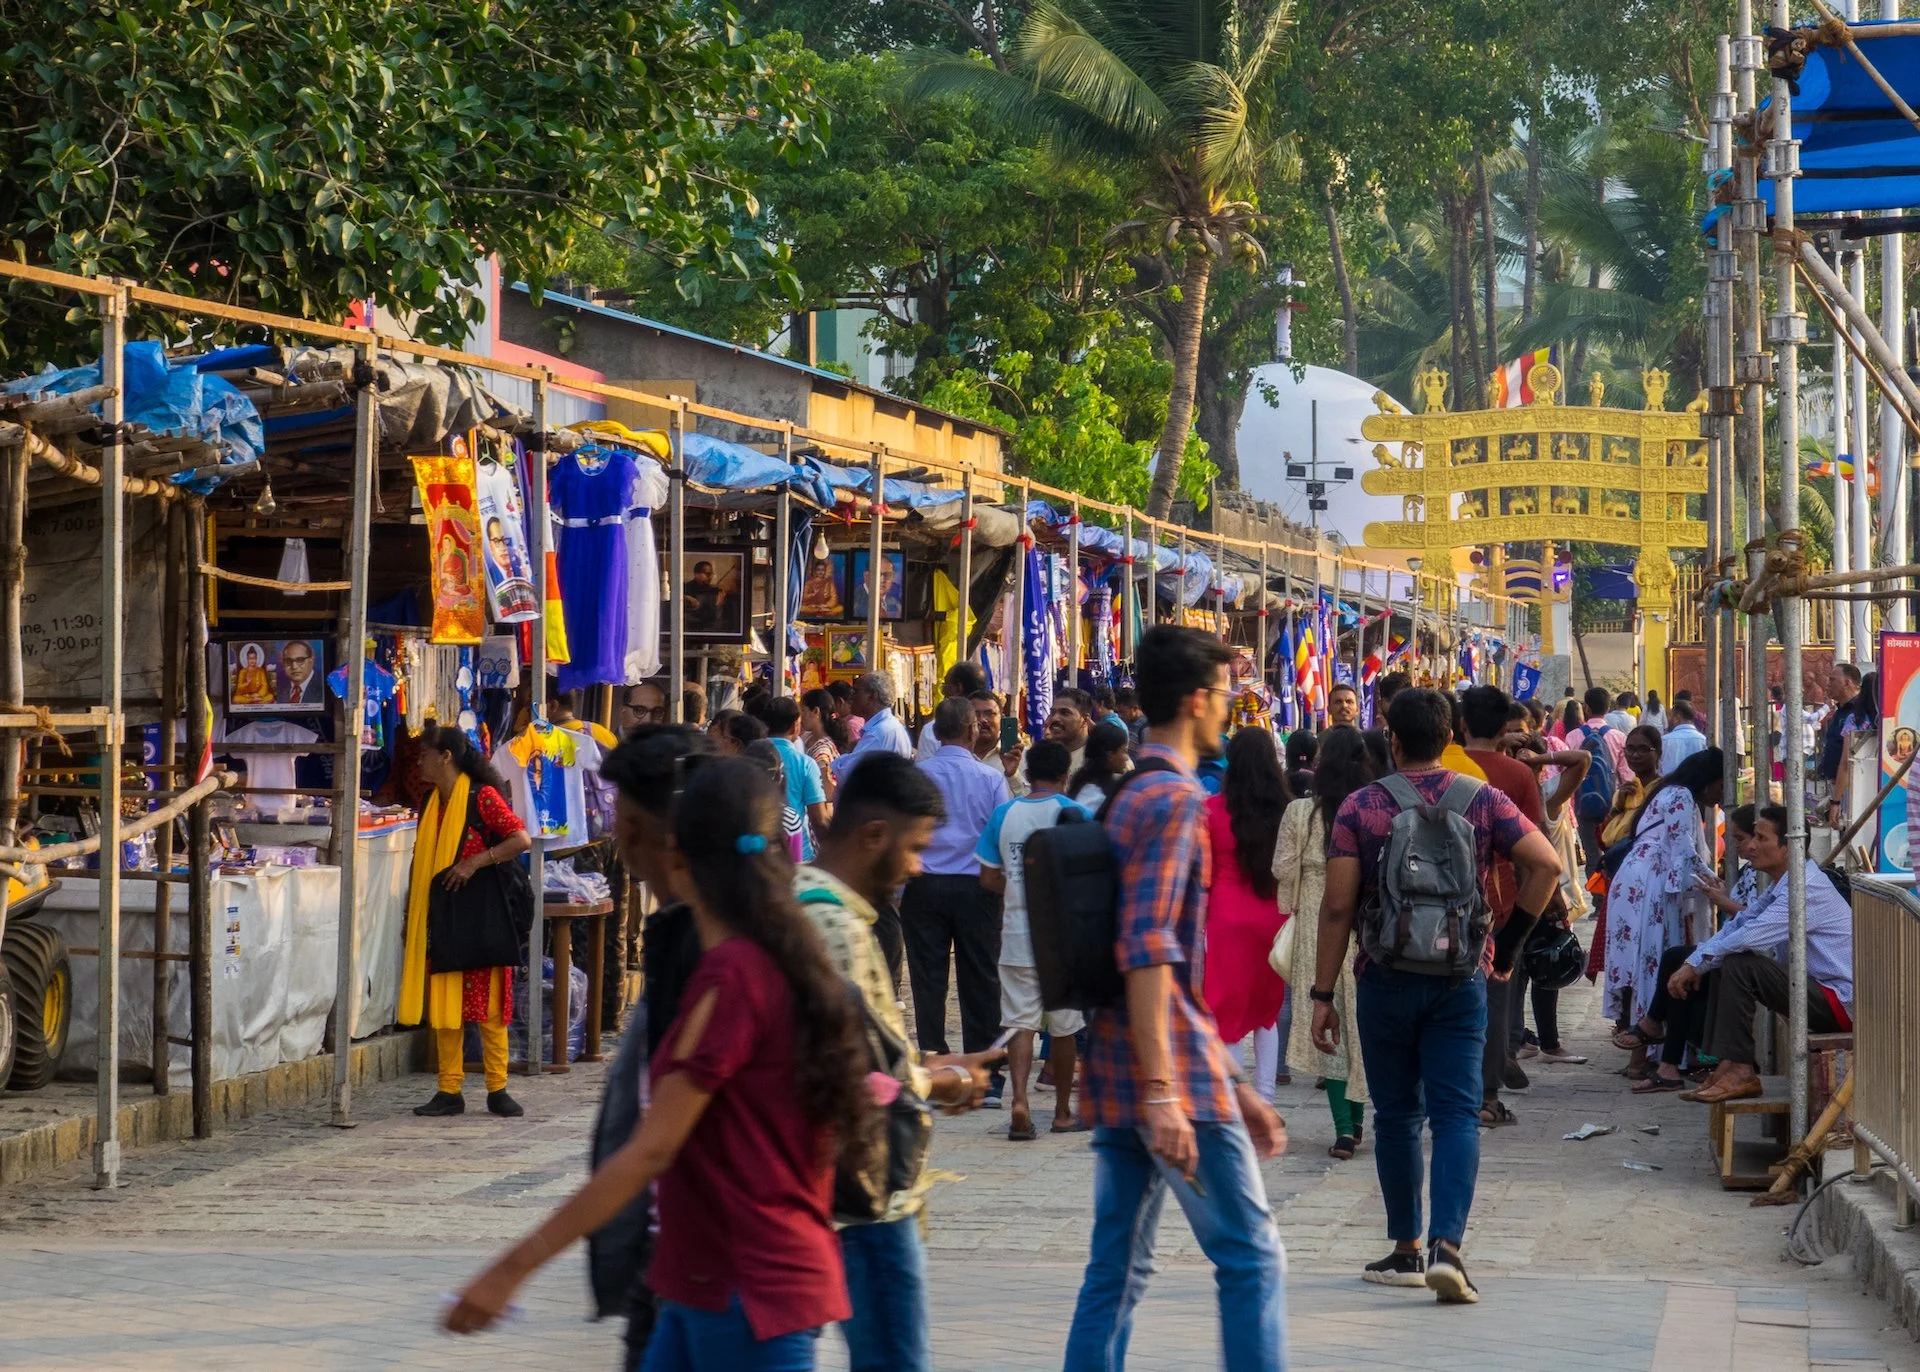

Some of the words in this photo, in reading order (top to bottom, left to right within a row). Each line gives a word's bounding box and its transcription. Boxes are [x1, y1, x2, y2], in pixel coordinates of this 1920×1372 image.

[24, 526, 46, 537] ne,
[50, 517, 83, 533] 7:00
[87, 518, 103, 531] p.
[52, 614, 94, 632] 11:30
[21, 641, 39, 657] ly,
[43, 636, 76, 652] 7:00
[1886, 638, 1912, 648] सोमवार
